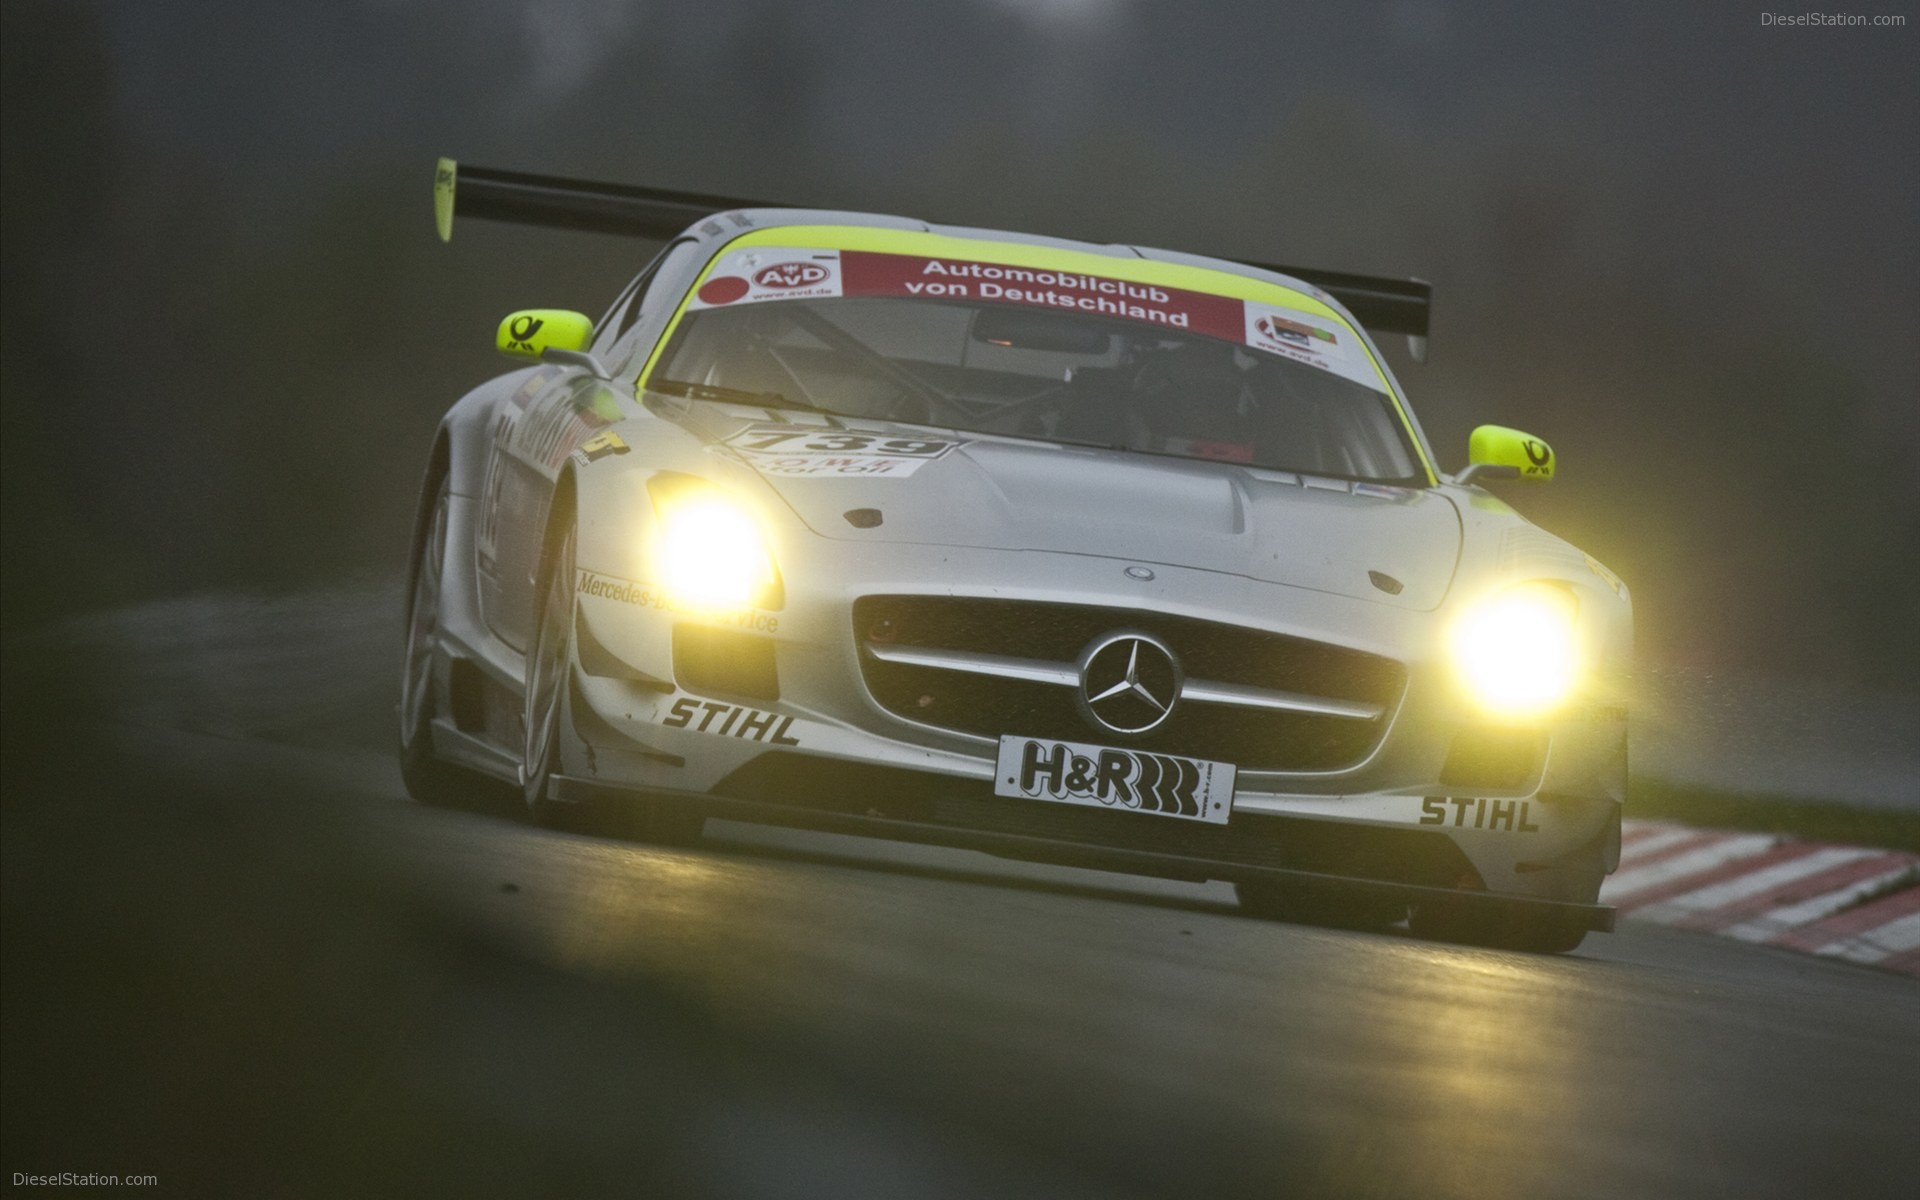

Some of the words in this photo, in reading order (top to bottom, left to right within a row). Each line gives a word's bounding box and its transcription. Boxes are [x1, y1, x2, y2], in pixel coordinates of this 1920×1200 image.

[760, 266, 826, 287] AvD
[922, 260, 1170, 303] Automobilclub
[905, 281, 968, 297] von
[979, 282, 1190, 328] Deutschland
[743, 432, 952, 454] 739
[662, 697, 800, 747] STIHL
[1020, 740, 1141, 808] H&R
[1419, 796, 1539, 832] STIHL
